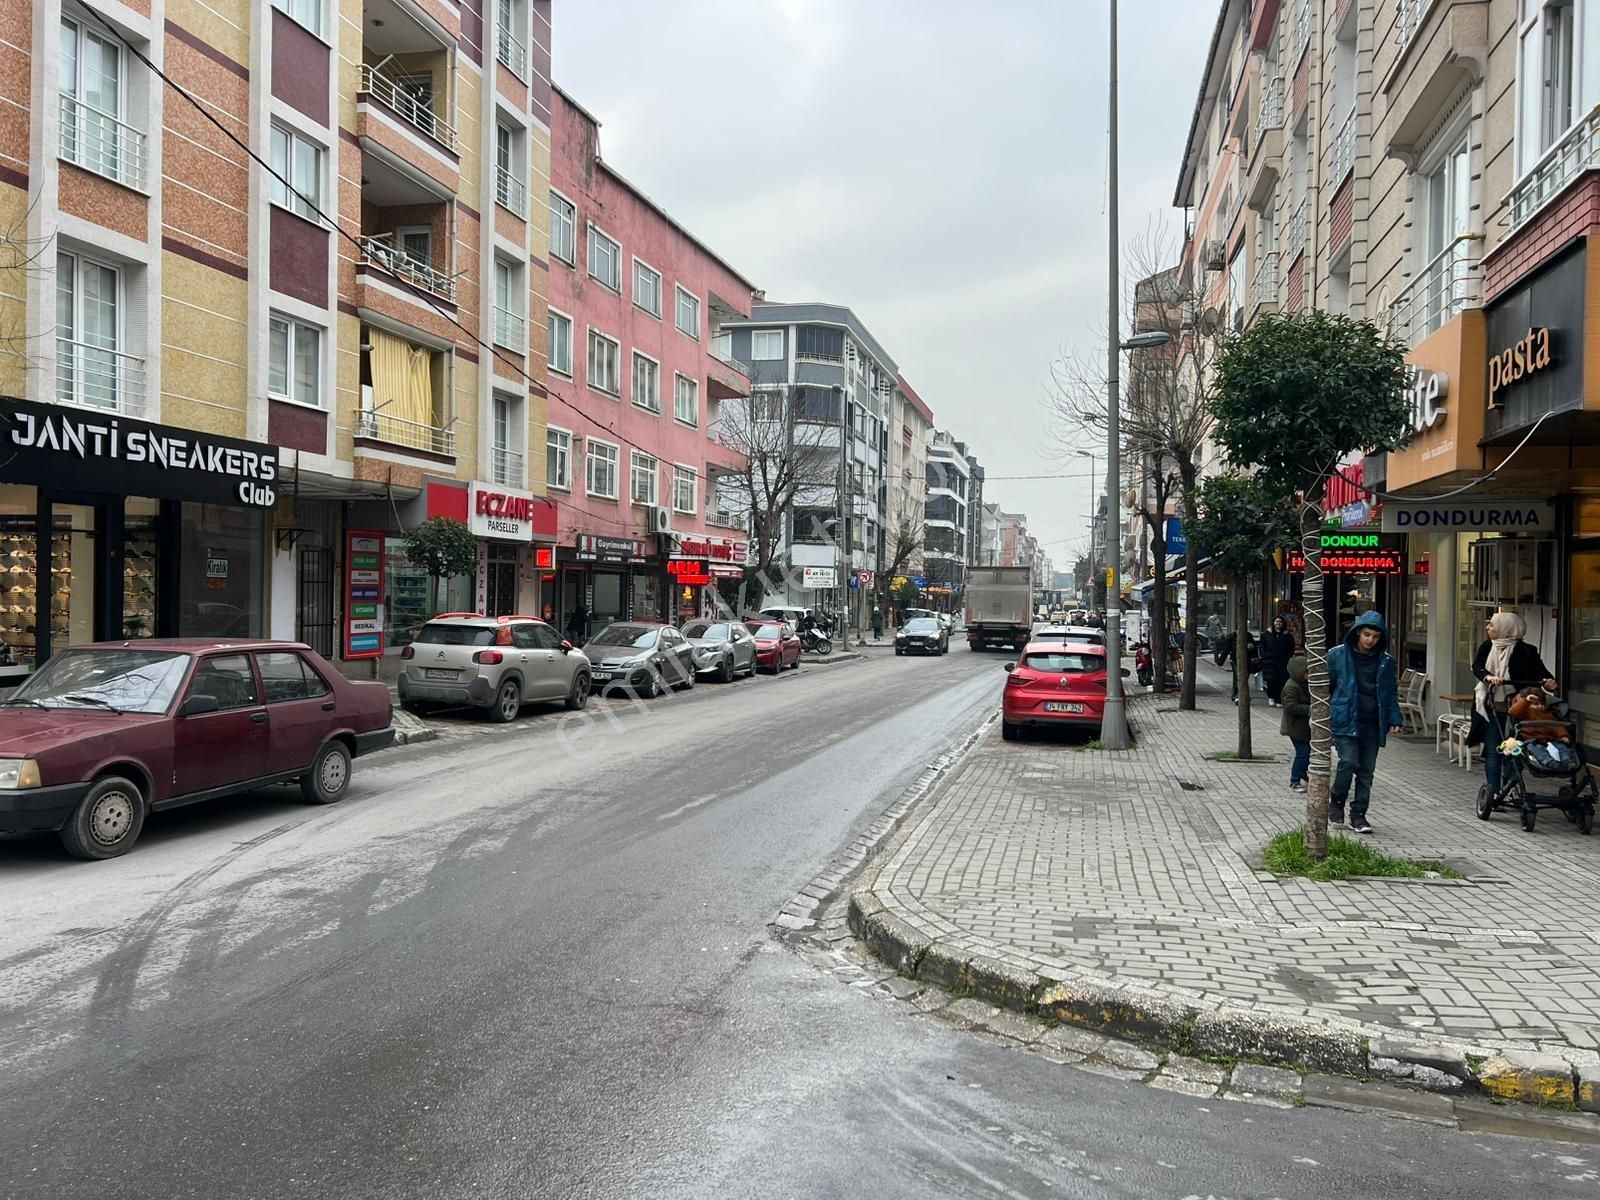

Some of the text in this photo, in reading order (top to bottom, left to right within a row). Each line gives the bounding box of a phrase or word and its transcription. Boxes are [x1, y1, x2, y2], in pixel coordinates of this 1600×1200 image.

[1487, 326, 1551, 410] pasta
[126, 429, 276, 482] SNEAKERS
[239, 481, 275, 507] Club
[476, 490, 534, 522] ECZANE
[487, 521, 519, 534] PARSELLER
[1397, 509, 1540, 527] DONDURMA
[1320, 535, 1379, 547] DONDUR
[1320, 557, 1395, 568] DONDURMA
